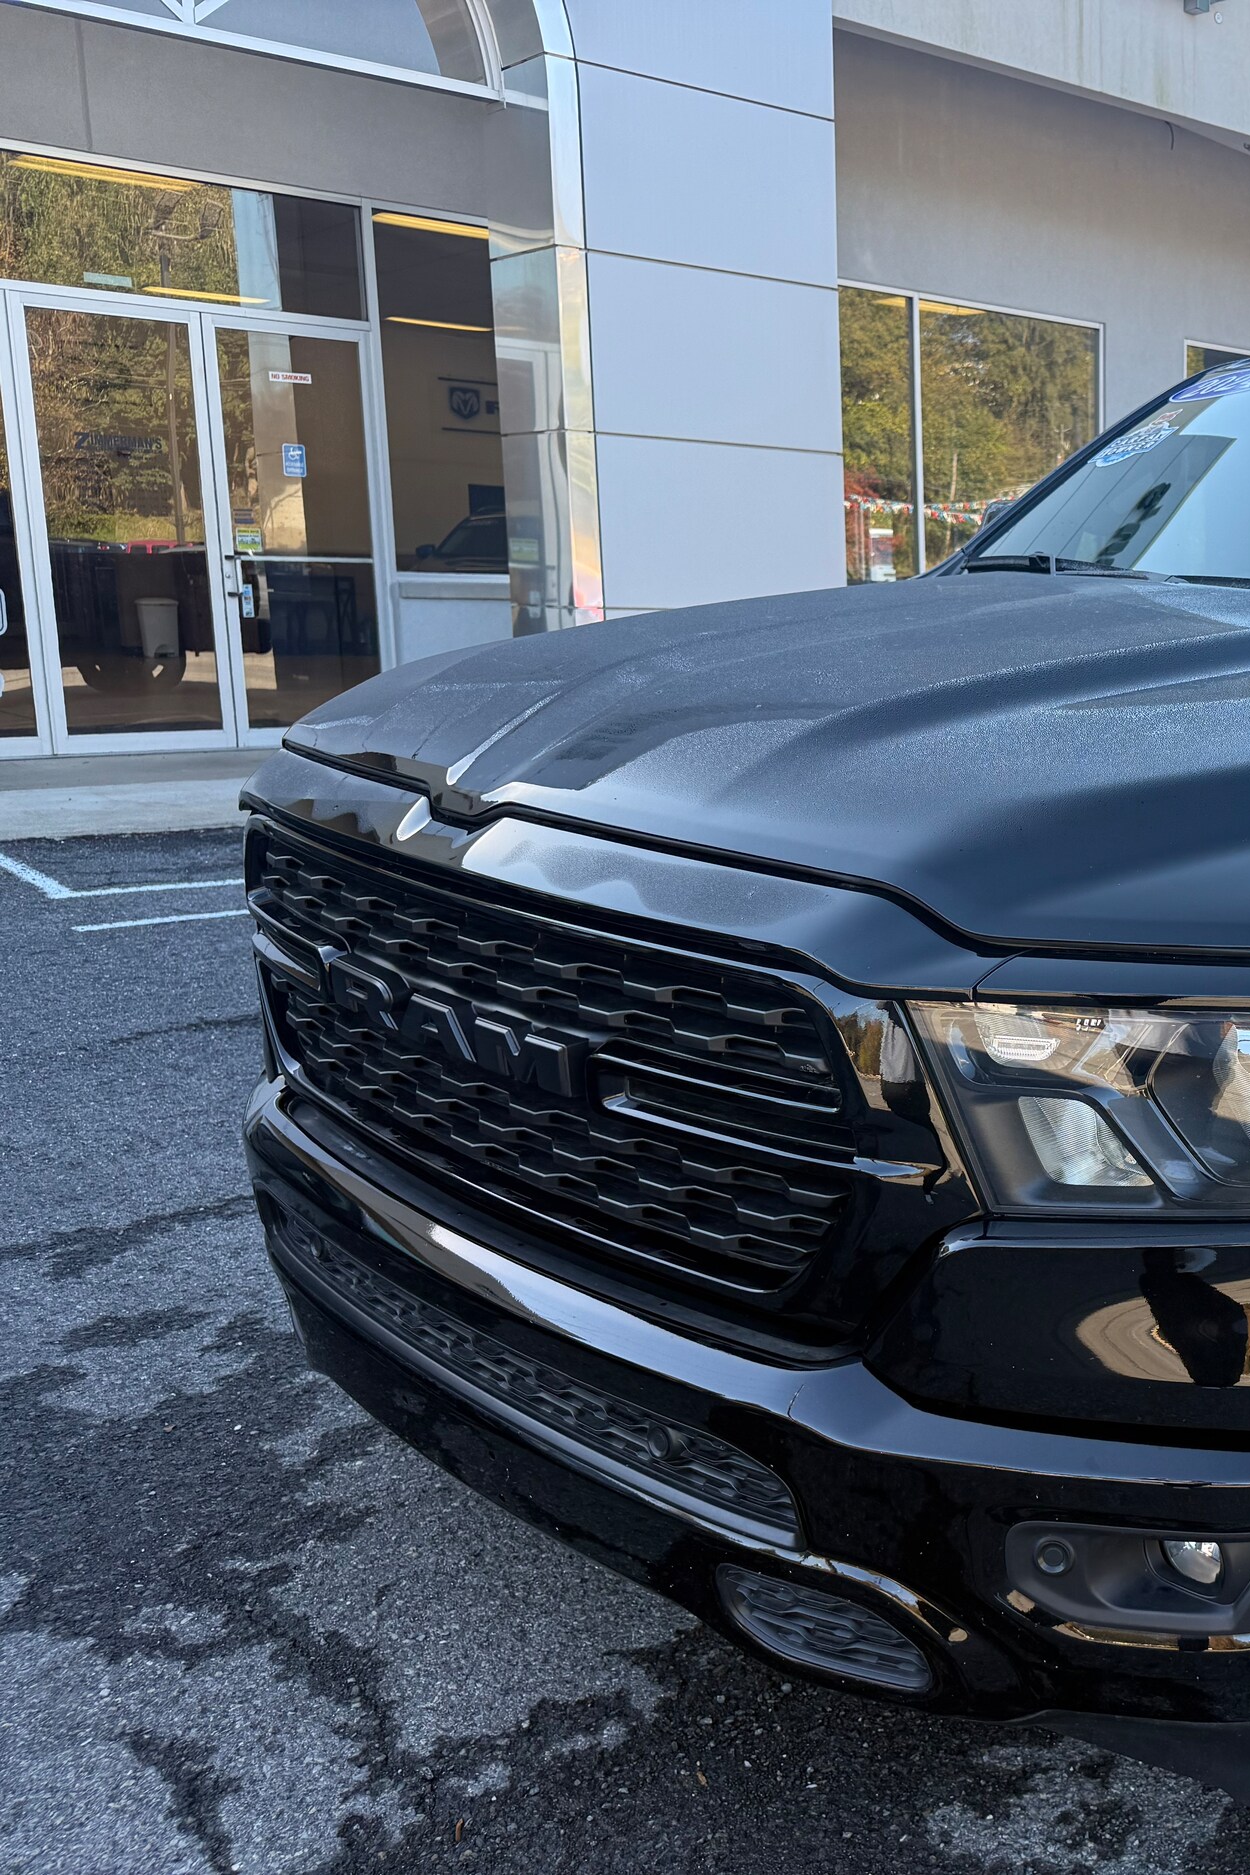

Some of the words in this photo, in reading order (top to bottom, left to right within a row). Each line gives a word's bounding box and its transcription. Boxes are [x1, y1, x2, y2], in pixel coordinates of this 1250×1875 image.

[281, 374, 310, 382] SMOKING
[74, 431, 163, 450] ZIMMERMAN'S
[330, 952, 588, 1098] RAM
